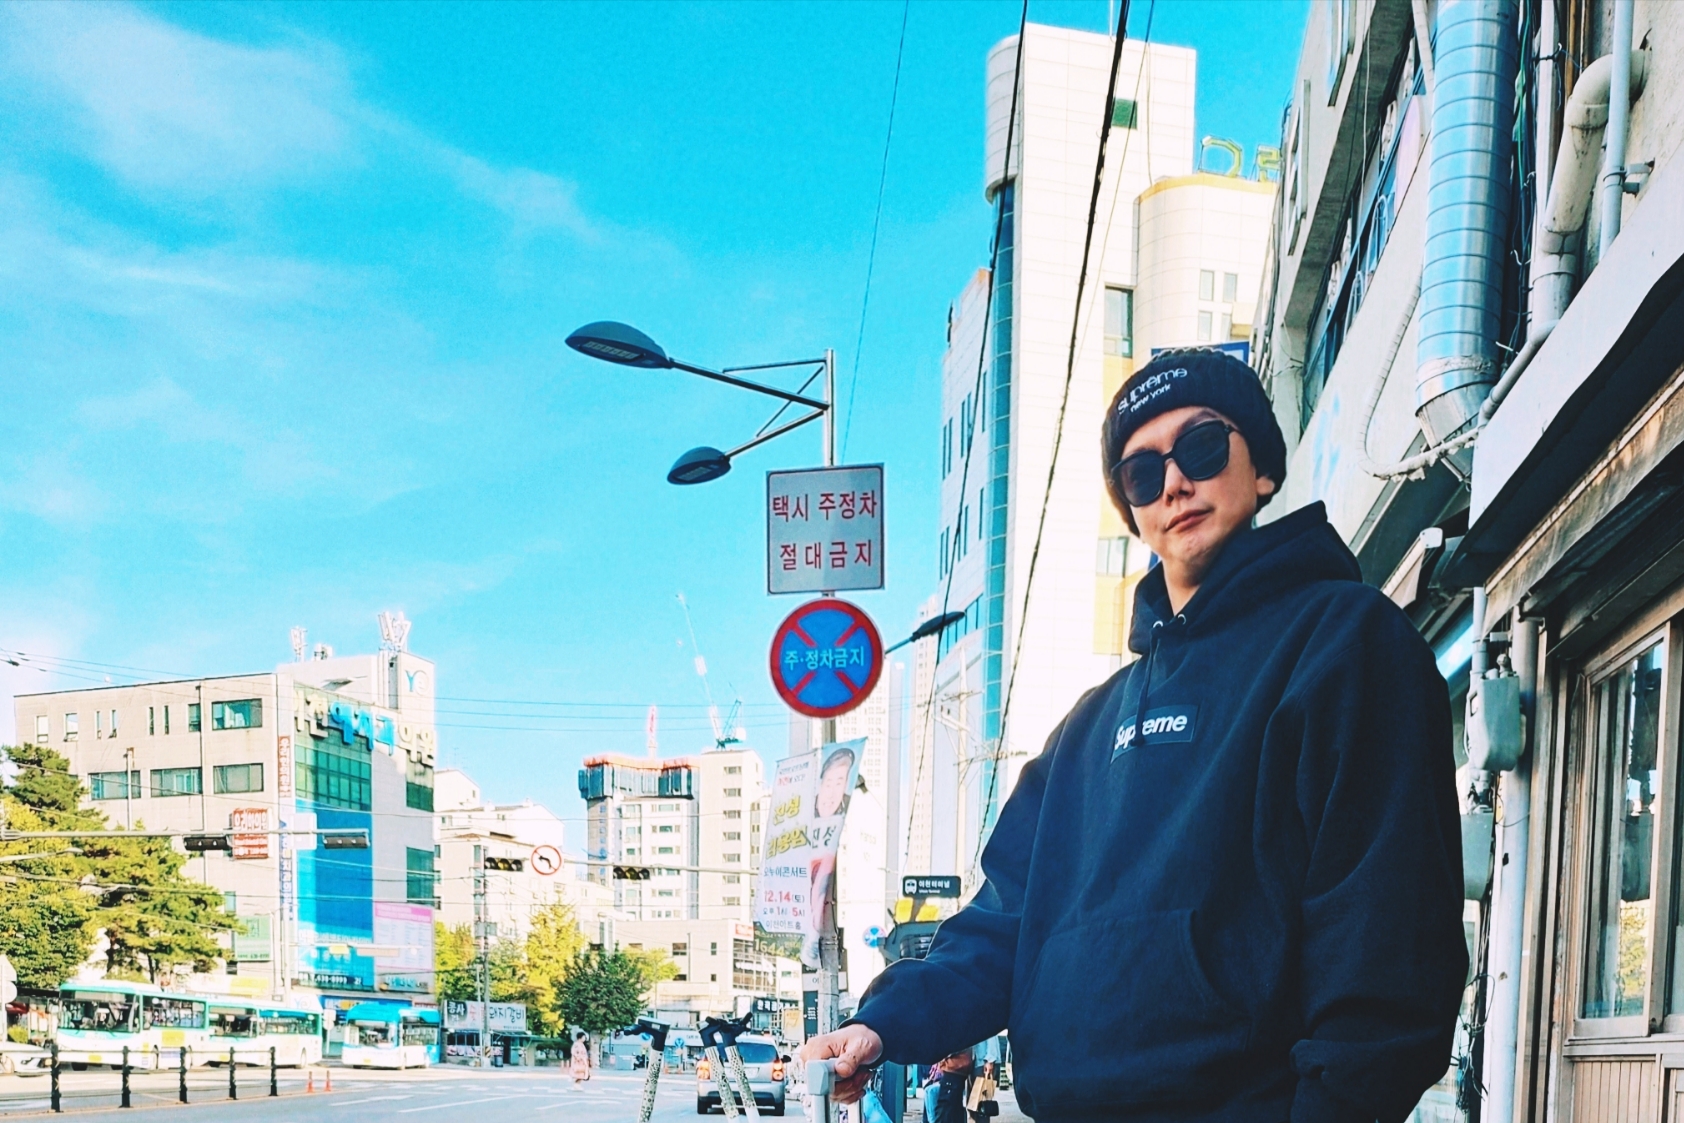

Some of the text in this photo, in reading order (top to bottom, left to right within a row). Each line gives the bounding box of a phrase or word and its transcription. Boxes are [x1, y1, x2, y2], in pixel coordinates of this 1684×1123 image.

[1130, 383, 1172, 414] new york
[772, 490, 877, 522] 택시 주정차
[1115, 715, 1188, 750] Supeme
